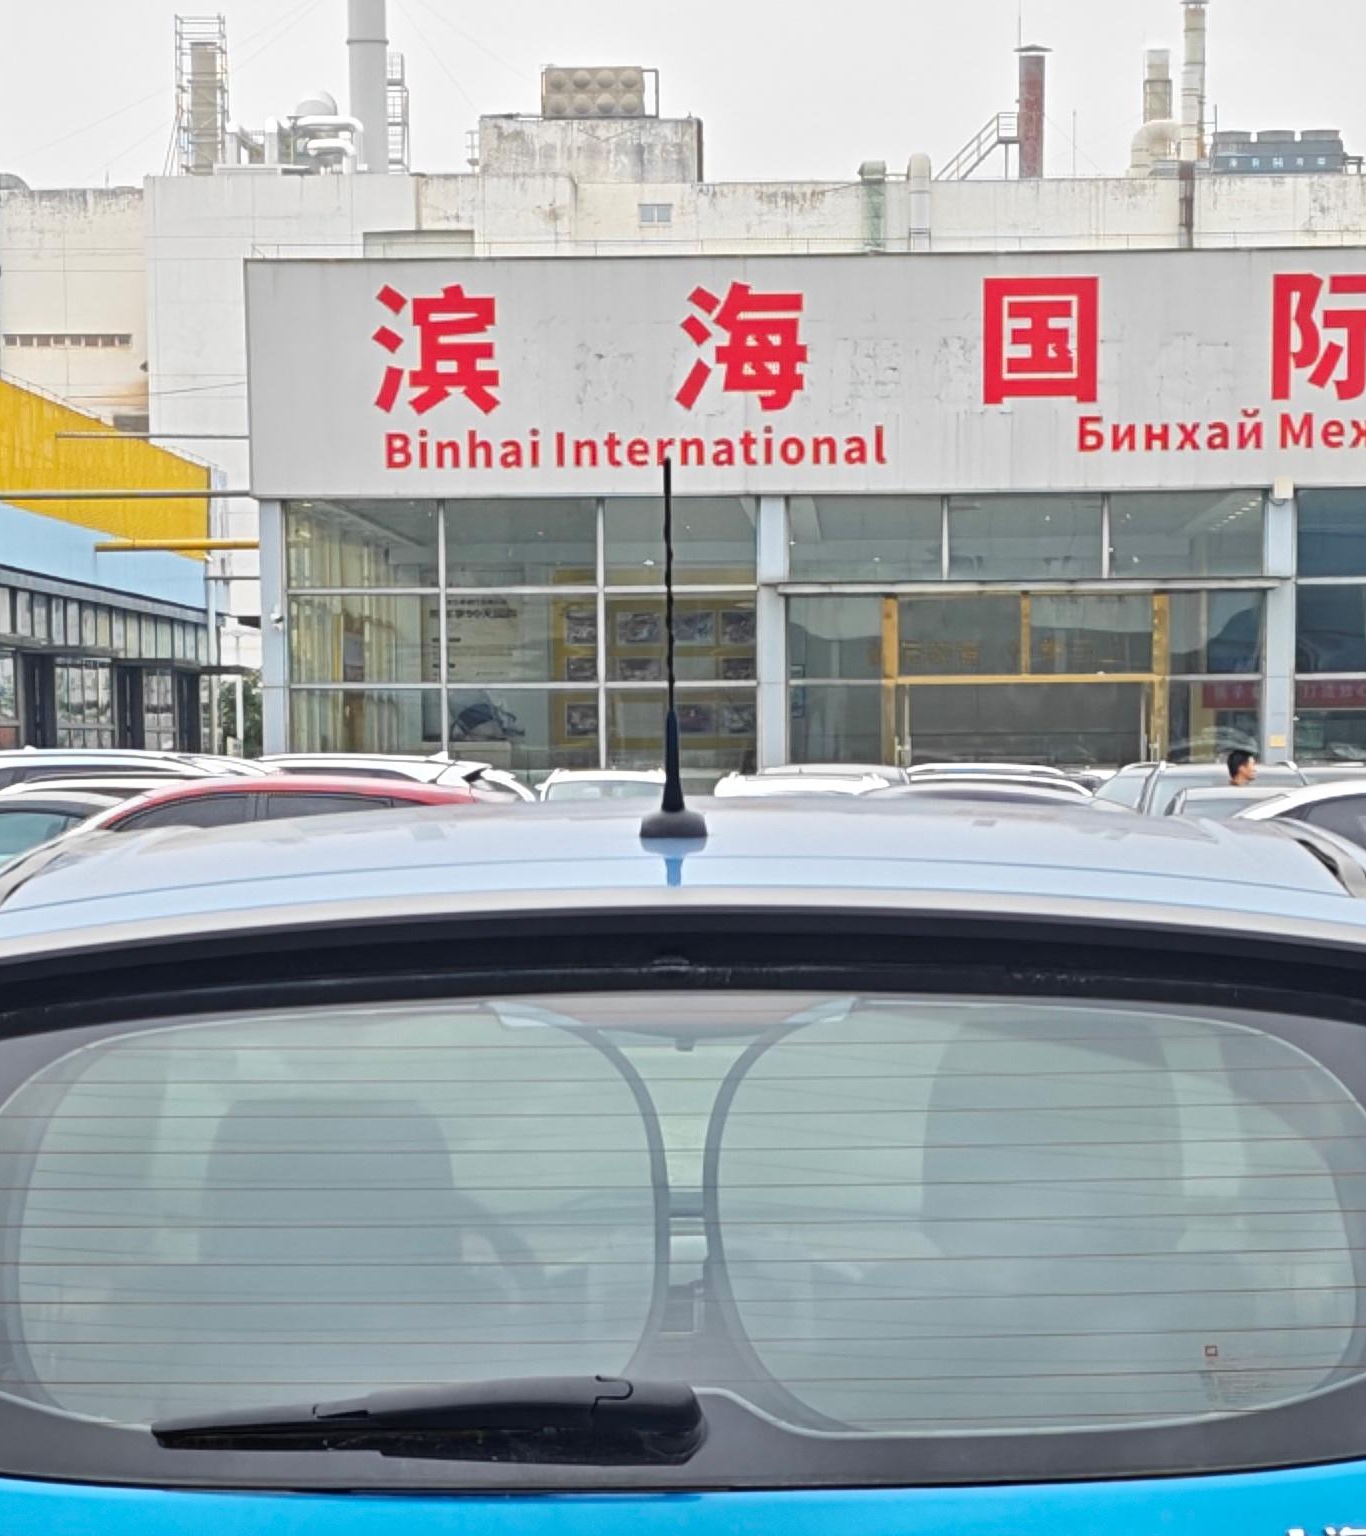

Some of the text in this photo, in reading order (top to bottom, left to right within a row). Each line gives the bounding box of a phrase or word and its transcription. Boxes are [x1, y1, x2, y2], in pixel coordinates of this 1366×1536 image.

[385, 425, 887, 470] Binhai International
[1077, 409, 1264, 453] Бинхай
